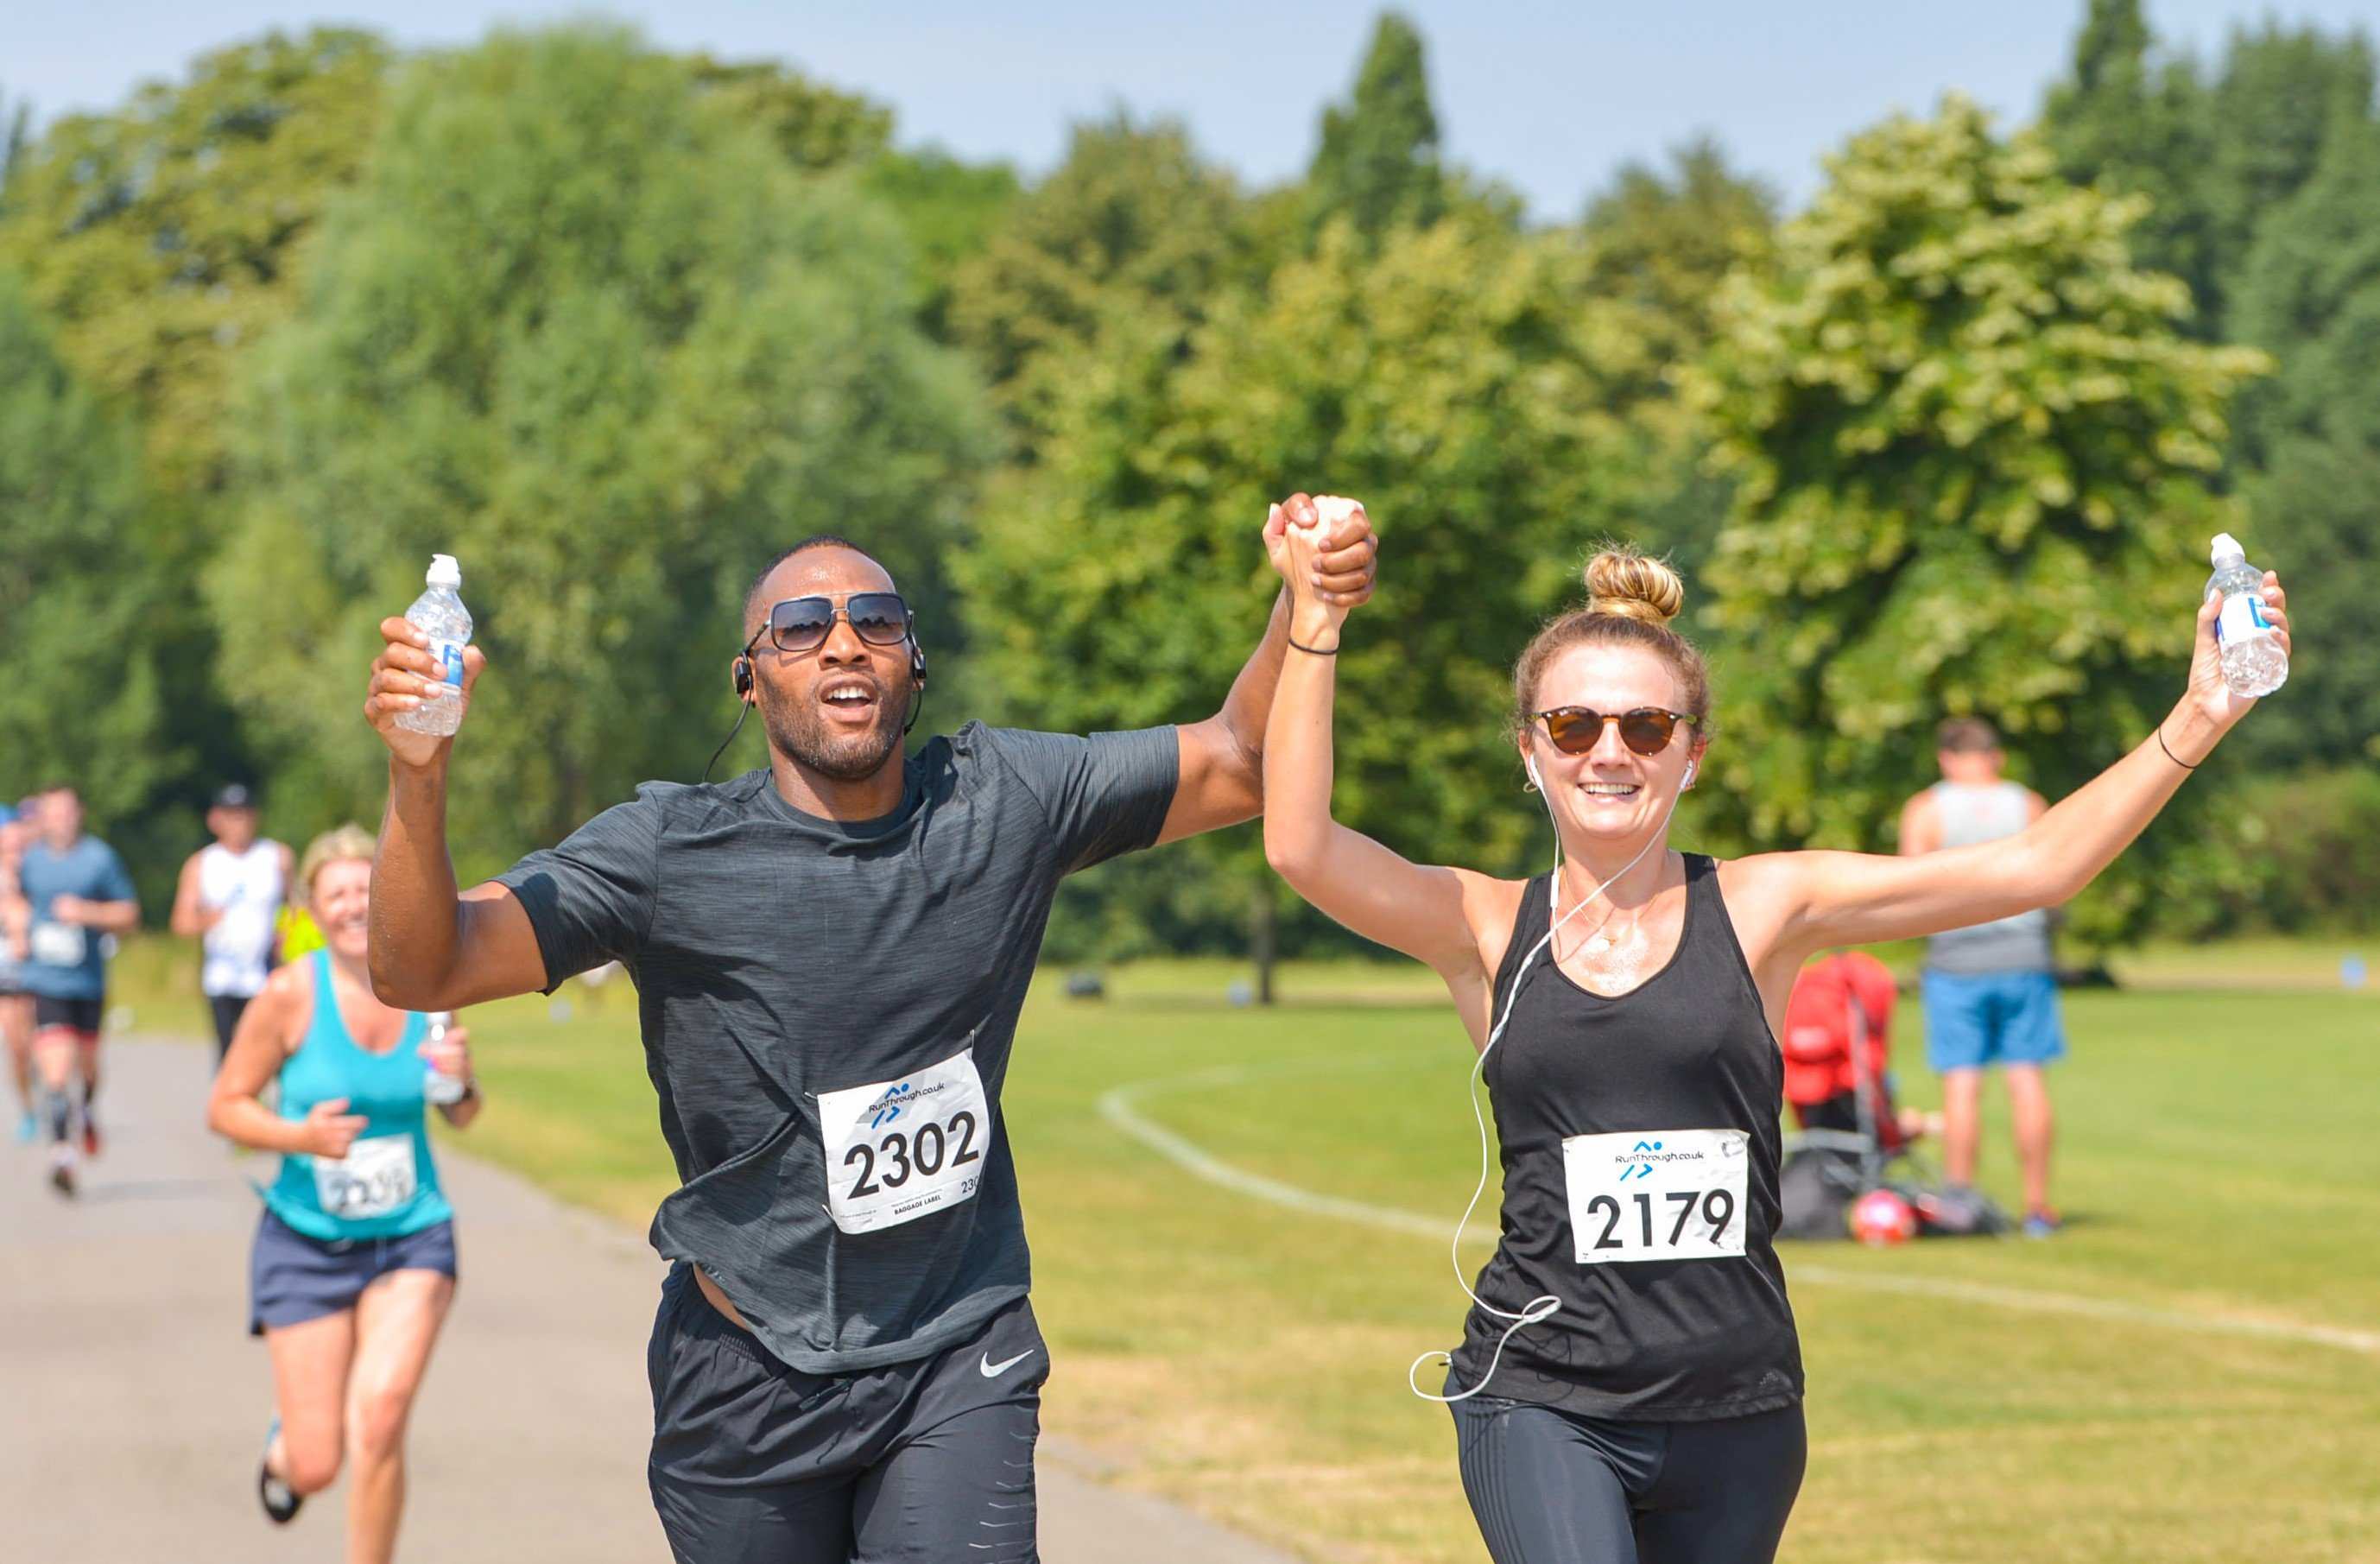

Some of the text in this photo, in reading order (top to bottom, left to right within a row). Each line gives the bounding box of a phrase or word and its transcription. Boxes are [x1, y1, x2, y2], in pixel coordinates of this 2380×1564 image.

[869, 1082, 945, 1113] RunThrough.co.uk
[844, 1111, 979, 1200] 2302
[1615, 1151, 1705, 1163] RunThrough.co.uk
[894, 1200, 923, 1215] BAGGAGE
[924, 1194, 942, 1205] LABEL
[1587, 1188, 1734, 1250] 2179
